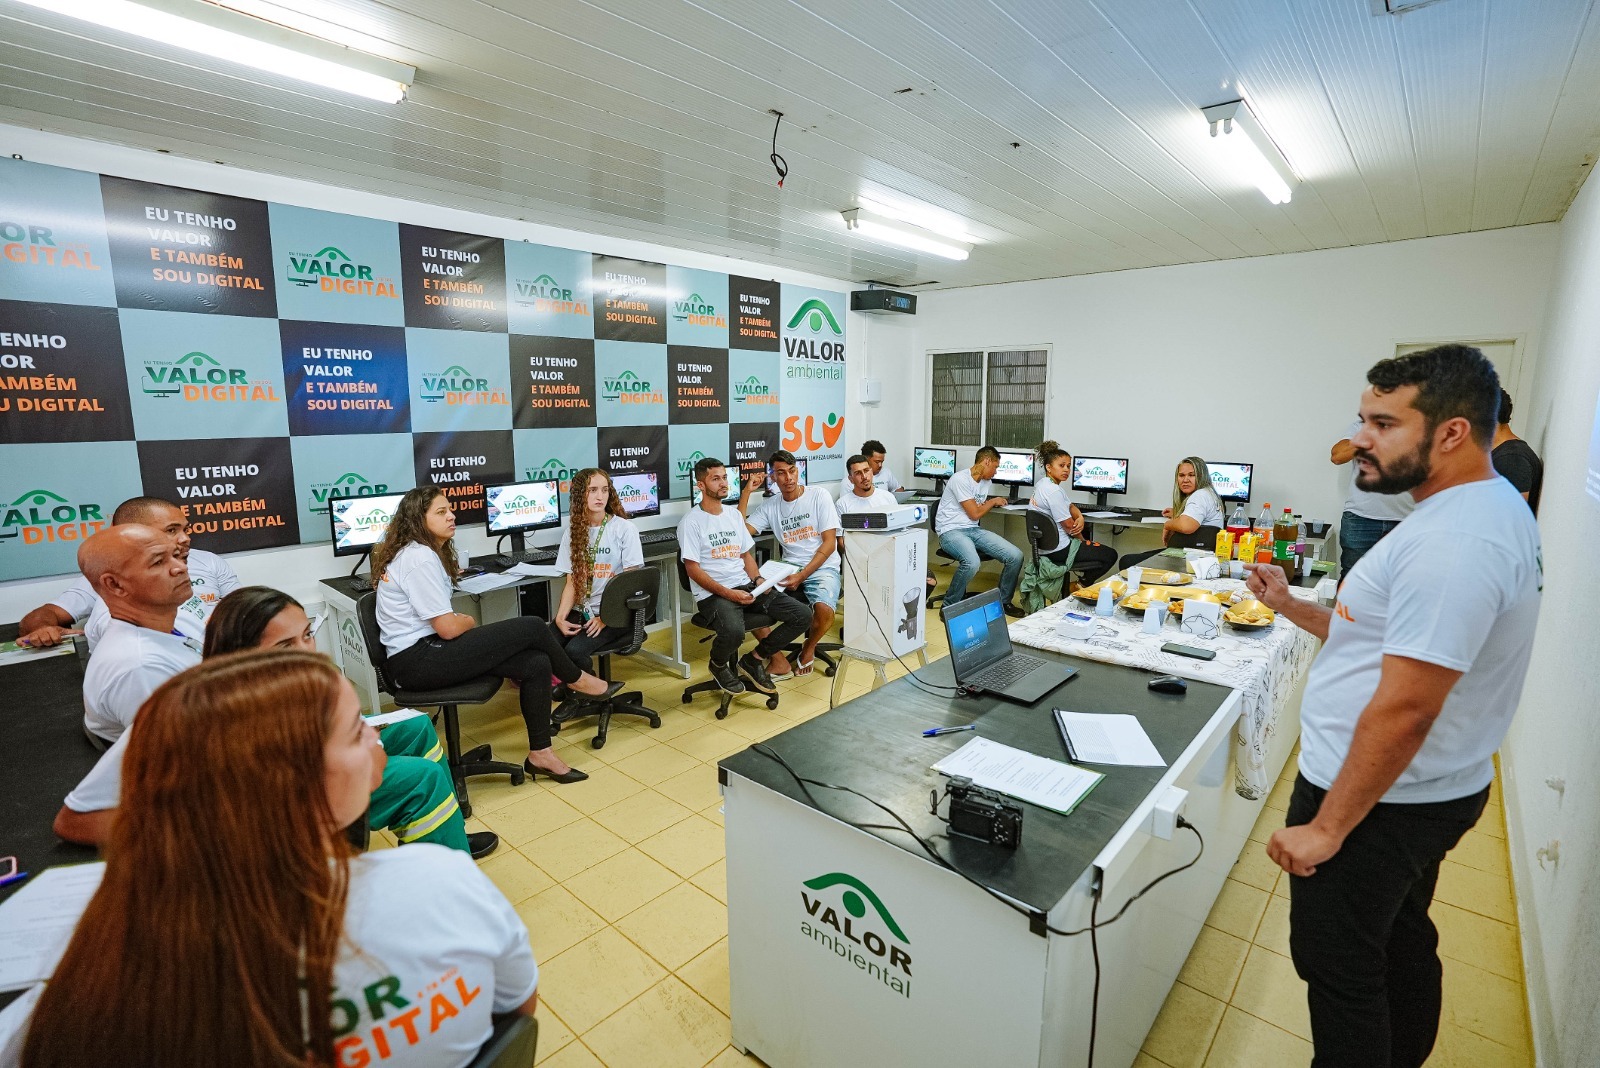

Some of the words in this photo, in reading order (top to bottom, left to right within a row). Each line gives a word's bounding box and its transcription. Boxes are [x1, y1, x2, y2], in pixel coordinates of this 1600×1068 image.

[145, 206, 169, 221] EU
[174, 211, 236, 230] TENHO
[146, 227, 211, 247] VALOR
[0, 243, 101, 270] GITAL
[150, 248, 161, 261] E
[165, 249, 243, 269] TAMBÉM
[422, 246, 437, 257] EU
[440, 249, 480, 263] TENHO
[290, 257, 373, 280] VALOR
[422, 262, 463, 277] VALOR
[153, 268, 191, 284] SOU
[197, 272, 264, 291] DIGITAL
[605, 272, 616, 281] EU
[617, 274, 647, 285] TENHO
[320, 276, 399, 299] DIGITAL
[424, 278, 430, 289] E
[433, 280, 484, 294] TAMBÉM
[517, 283, 573, 301] VALOR
[425, 295, 449, 306] SOU
[452, 297, 497, 311] DIGITAL
[605, 299, 611, 308] E
[612, 299, 648, 311] TAMBÉM
[740, 294, 748, 302] EU
[749, 295, 770, 306] TENHO
[536, 298, 591, 317] DIGITAL
[675, 301, 715, 316] VALOR
[740, 305, 761, 315] VALOR
[606, 312, 624, 321] SOU
[625, 314, 657, 325] DIGITAL
[688, 314, 727, 328] DIGITAL
[740, 316, 744, 325] E
[745, 317, 771, 327] TAMBÉM
[0, 332, 67, 349] ENHO
[740, 328, 753, 336] SOU
[754, 329, 777, 339] DIGITAL
[302, 347, 321, 359] EU
[324, 348, 373, 361] TENHO
[784, 337, 845, 361] VALOR
[530, 357, 543, 366] EU
[545, 357, 578, 367] TENHO
[677, 363, 687, 372] EU
[688, 364, 713, 373] TENHO
[145, 367, 249, 385] VALOR
[303, 365, 353, 377] VALOR
[530, 371, 564, 380] VALOR
[787, 363, 843, 380] ambiental
[0, 374, 77, 391] AMBÉM
[422, 378, 489, 392] VALOR
[604, 381, 651, 392] VALOR
[677, 375, 702, 384] VALOR
[183, 385, 280, 402] DIGITAL
[306, 382, 314, 393] E
[317, 380, 378, 394] TAMBÉM
[531, 385, 537, 394] E
[539, 383, 580, 395] TAMBÉM
[678, 387, 682, 395] E
[683, 386, 714, 396] TAMBÉM
[735, 385, 769, 395] VALOR
[17, 398, 105, 412] DIGITAL
[307, 399, 337, 410] SOU
[341, 399, 394, 410] DIGITAL
[446, 392, 510, 406] DIGITAL
[532, 399, 552, 408] SOU
[555, 399, 591, 408] DIGITAL
[621, 393, 665, 404] DIGITAL
[678, 399, 693, 408] SOU
[694, 399, 721, 408] DIGITAL
[746, 395, 779, 405] DIGITAL
[610, 448, 621, 457] EU
[622, 446, 650, 456] TENHO
[736, 441, 744, 450] EU
[745, 440, 766, 448] TENHO
[430, 458, 446, 469] EU
[447, 455, 487, 468] TENHO
[736, 451, 757, 460] VALOR
[610, 459, 638, 470] VALOR
[175, 467, 198, 480] EU
[201, 464, 259, 479] TENHO
[431, 471, 471, 484] VALOR
[176, 483, 237, 499] VALOR
[460, 499, 485, 511] DIGI
[504, 499, 536, 510] VALOR
[623, 494, 649, 503] DIGITAL
[180, 505, 190, 517] E
[193, 497, 266, 516] TAMBÉM
[515, 505, 547, 516] DIGITAL
[2, 504, 104, 528] ALOR
[222, 515, 286, 531] DIGITAL
[790, 513, 810, 524] TENHO
[22, 521, 105, 545] DIGIT
[782, 522, 801, 532] VALOR
[708, 532, 718, 541] EU
[801, 890, 912, 977] VALOR
[801, 921, 911, 999] ambiental
